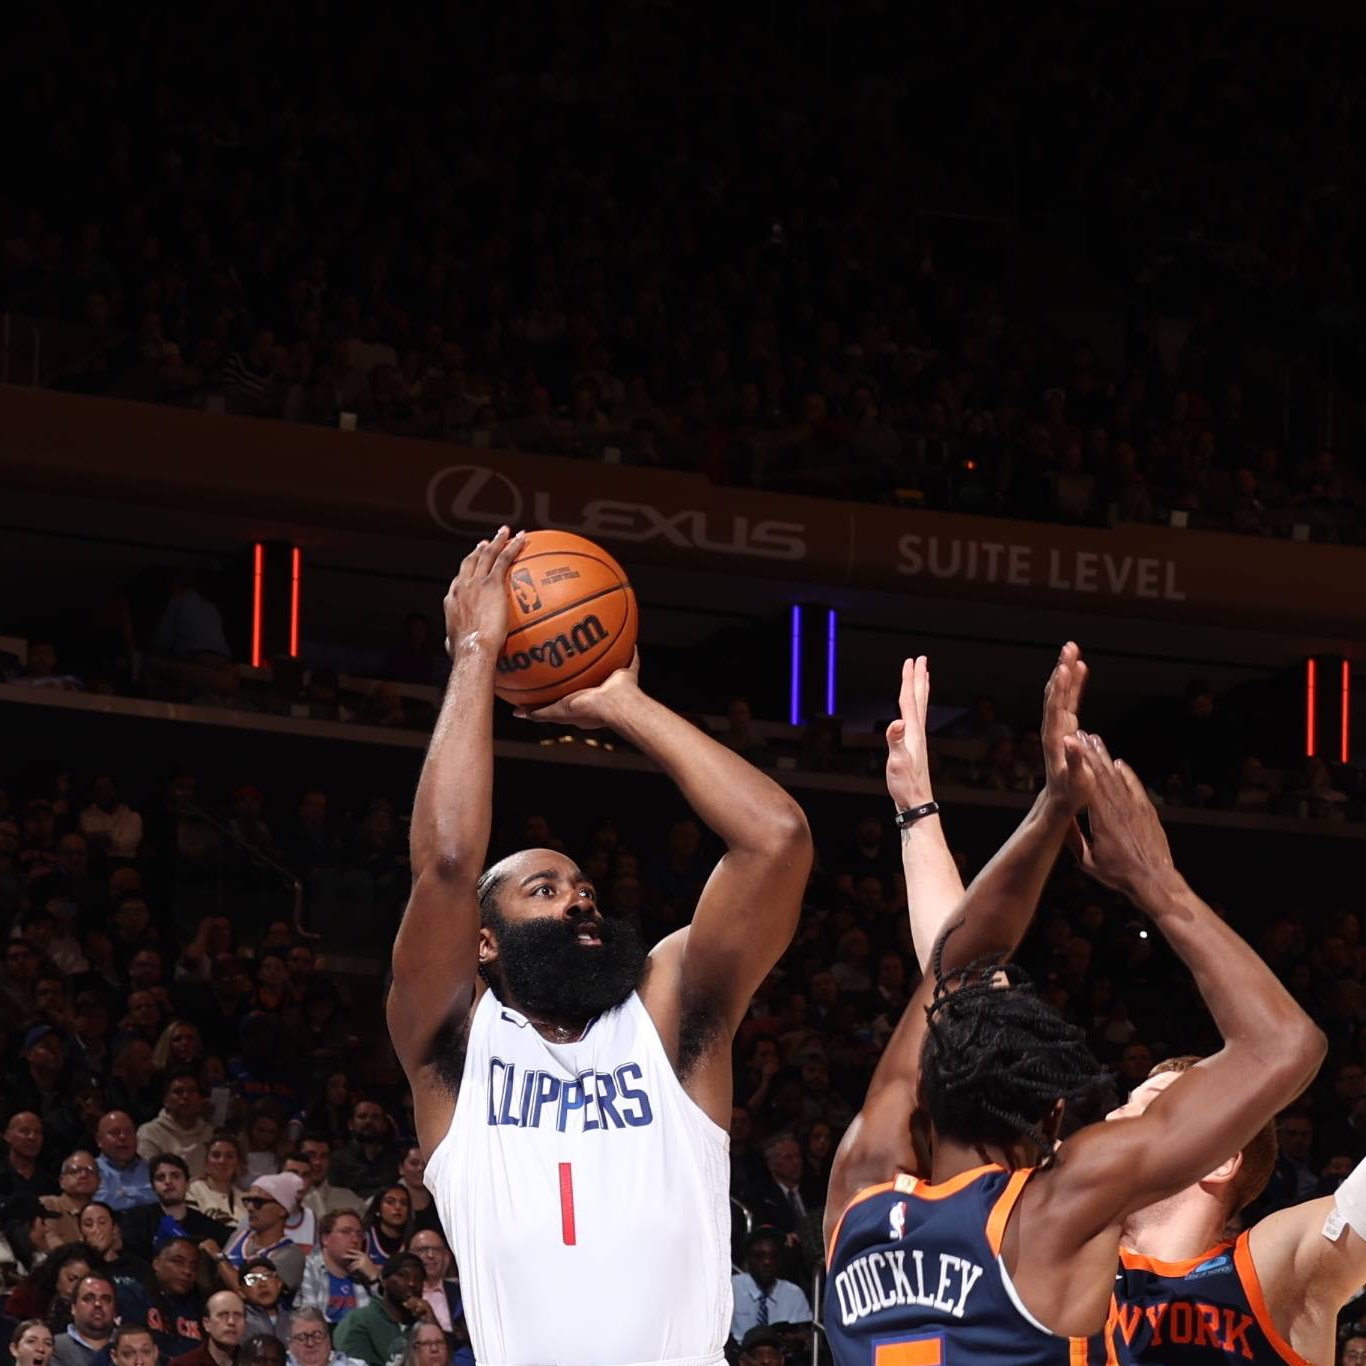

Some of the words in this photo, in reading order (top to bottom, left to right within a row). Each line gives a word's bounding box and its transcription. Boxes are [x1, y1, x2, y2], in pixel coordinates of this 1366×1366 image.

[534, 491, 807, 560] LEXUS
[896, 533, 1032, 586] SUITE
[1047, 548, 1187, 601] LEVEL
[496, 614, 609, 673] Wilson
[487, 1056, 654, 1133] CLIPPERS
[558, 1162, 576, 1246] 1
[835, 1250, 983, 1327] QUICKLEY
[1145, 1300, 1255, 1361] YORK
